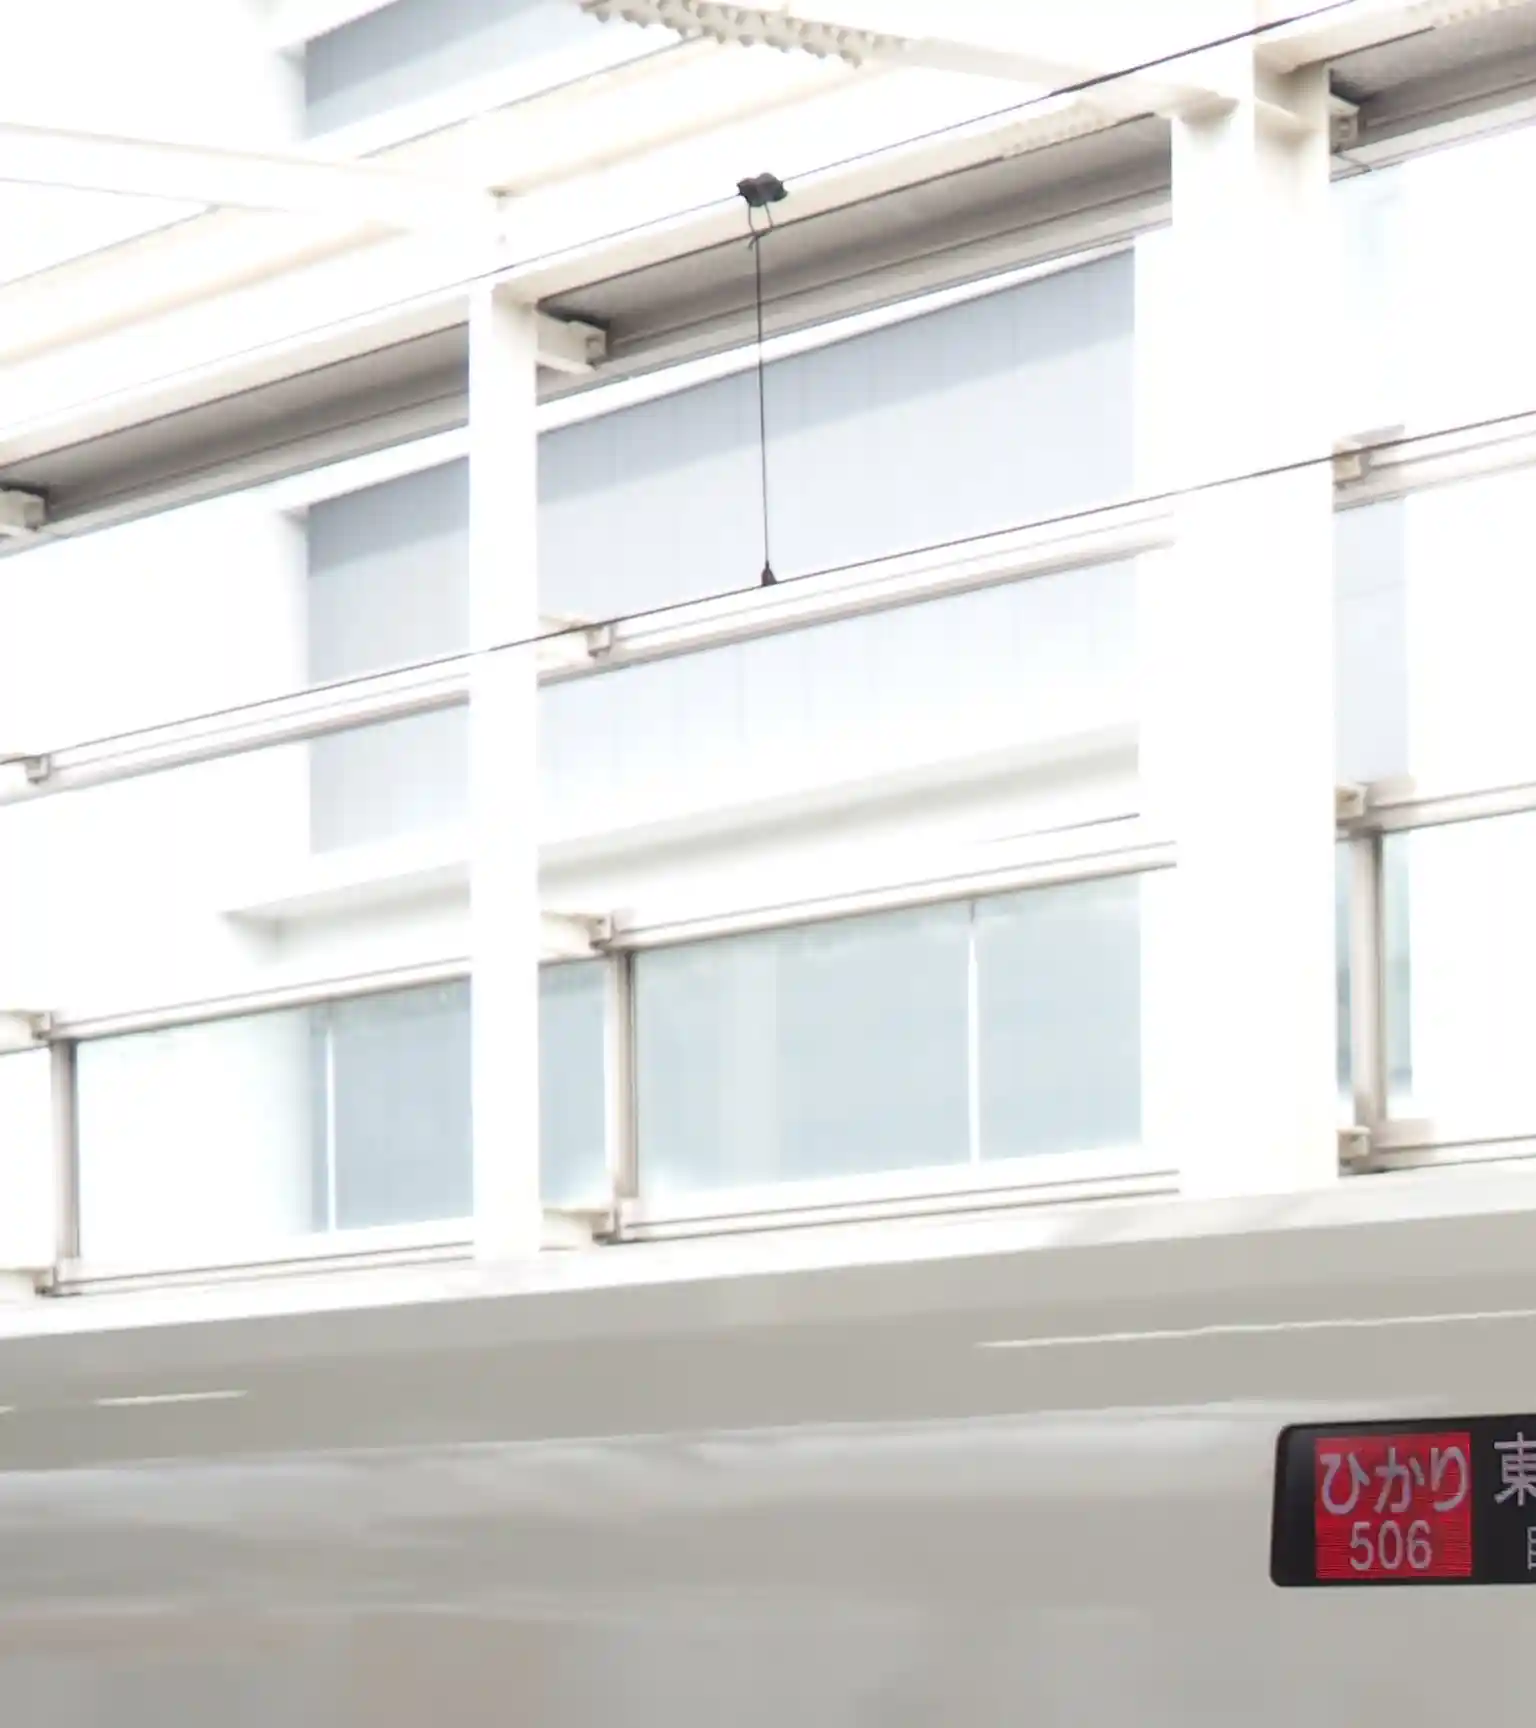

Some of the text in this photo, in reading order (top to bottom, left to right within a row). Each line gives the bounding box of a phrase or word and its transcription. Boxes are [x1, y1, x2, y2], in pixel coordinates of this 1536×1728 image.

[1319, 1446, 1470, 1515] ひかり
[1349, 1519, 1433, 1571] 506
